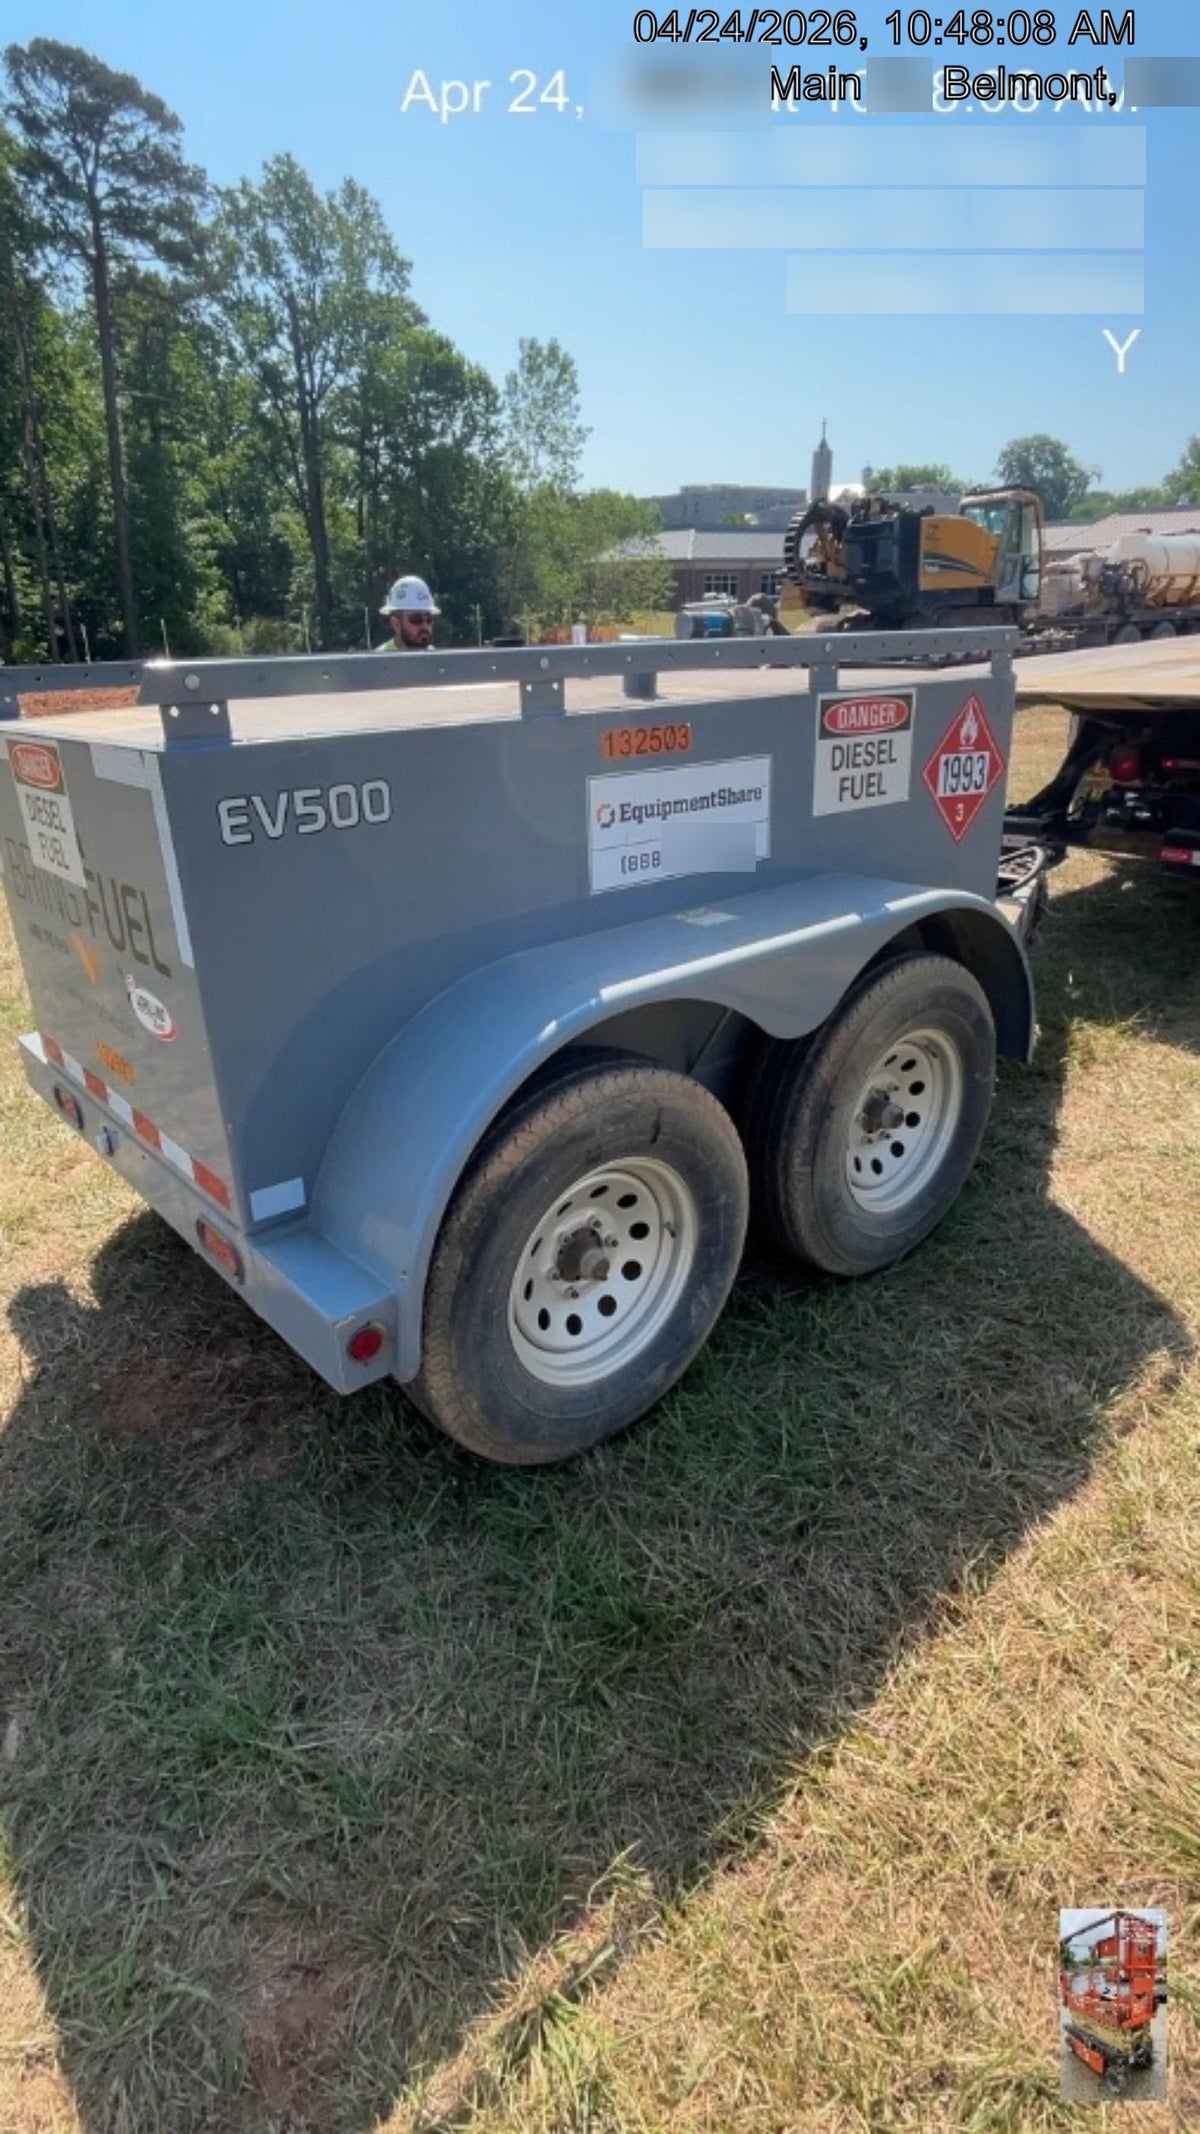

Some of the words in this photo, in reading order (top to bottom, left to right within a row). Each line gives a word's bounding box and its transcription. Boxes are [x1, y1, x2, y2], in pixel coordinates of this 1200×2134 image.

[836, 703, 898, 729] DANGER
[604, 724, 690, 758] 132503
[831, 739, 897, 772] DIESEL
[838, 772, 888, 802] FUEL
[942, 754, 987, 795] 1993
[217, 777, 393, 847] EV500
[618, 785, 763, 825] EquipmentShare
[955, 803, 965, 821] 3
